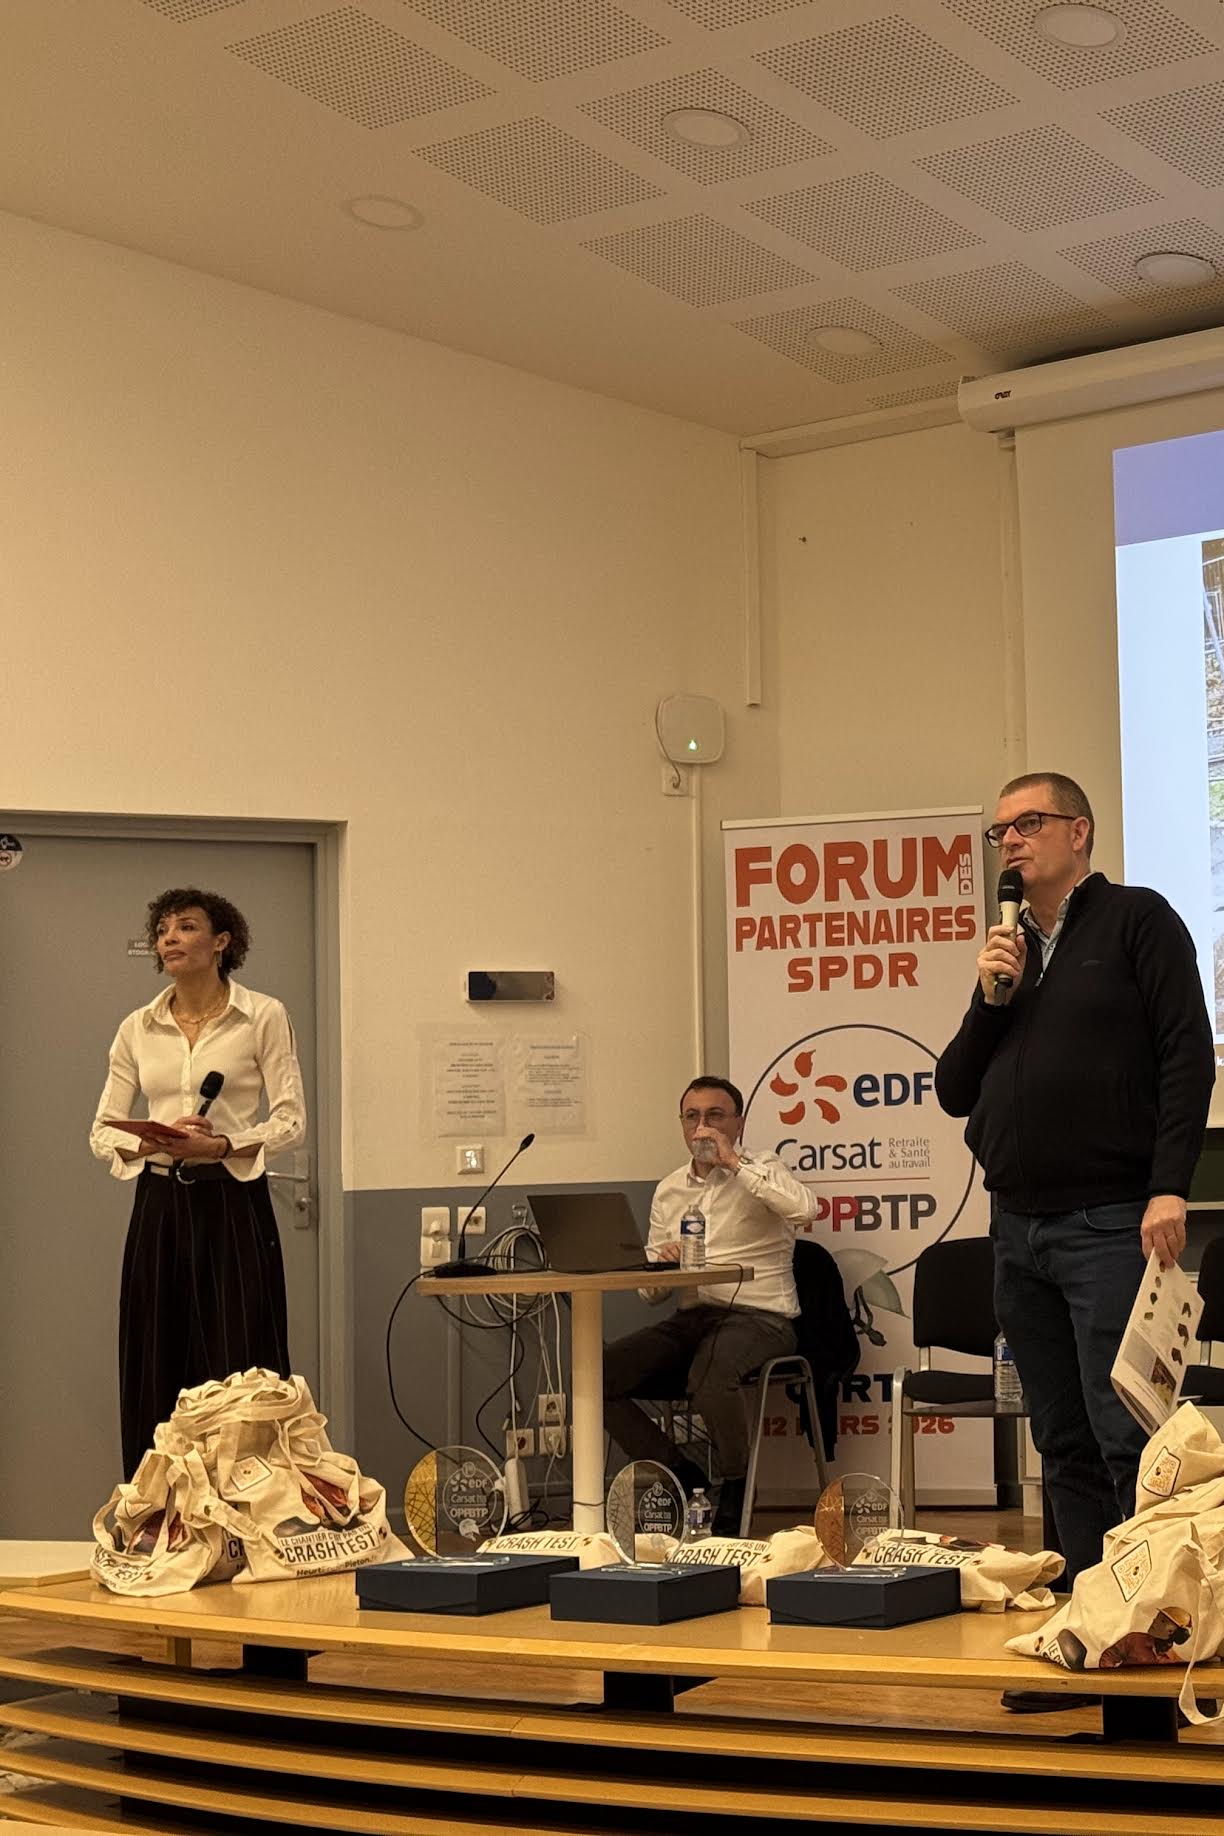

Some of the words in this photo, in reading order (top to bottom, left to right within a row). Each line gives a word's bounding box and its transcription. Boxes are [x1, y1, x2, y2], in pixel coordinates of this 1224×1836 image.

[735, 834, 973, 908] FORUM
[958, 852, 974, 896] DES
[735, 904, 976, 952] PARTENAIRES
[787, 951, 920, 993] SPDR
[853, 1071, 934, 1108] eDF
[775, 1136, 883, 1171] Carsat
[888, 1137, 930, 1148] Retraite
[888, 1149, 898, 1159] &
[900, 1146, 931, 1158] Santé
[888, 1159, 901, 1169] au
[901, 1156, 931, 1168] travail
[804, 1193, 938, 1233] PPBTP
[281, 1538, 290, 1547] LE
[290, 1532, 327, 1545] CHANTIER
[285, 1540, 338, 1563] CRASH
[337, 1530, 377, 1556] TEST
[496, 1536, 542, 1550] CRASH
[543, 1536, 580, 1550] TEST
[874, 1545, 928, 1564] CRASH
[928, 1552, 971, 1566] TEST
[673, 1548, 722, 1565] CRASH
[721, 1548, 762, 1567] TEST
